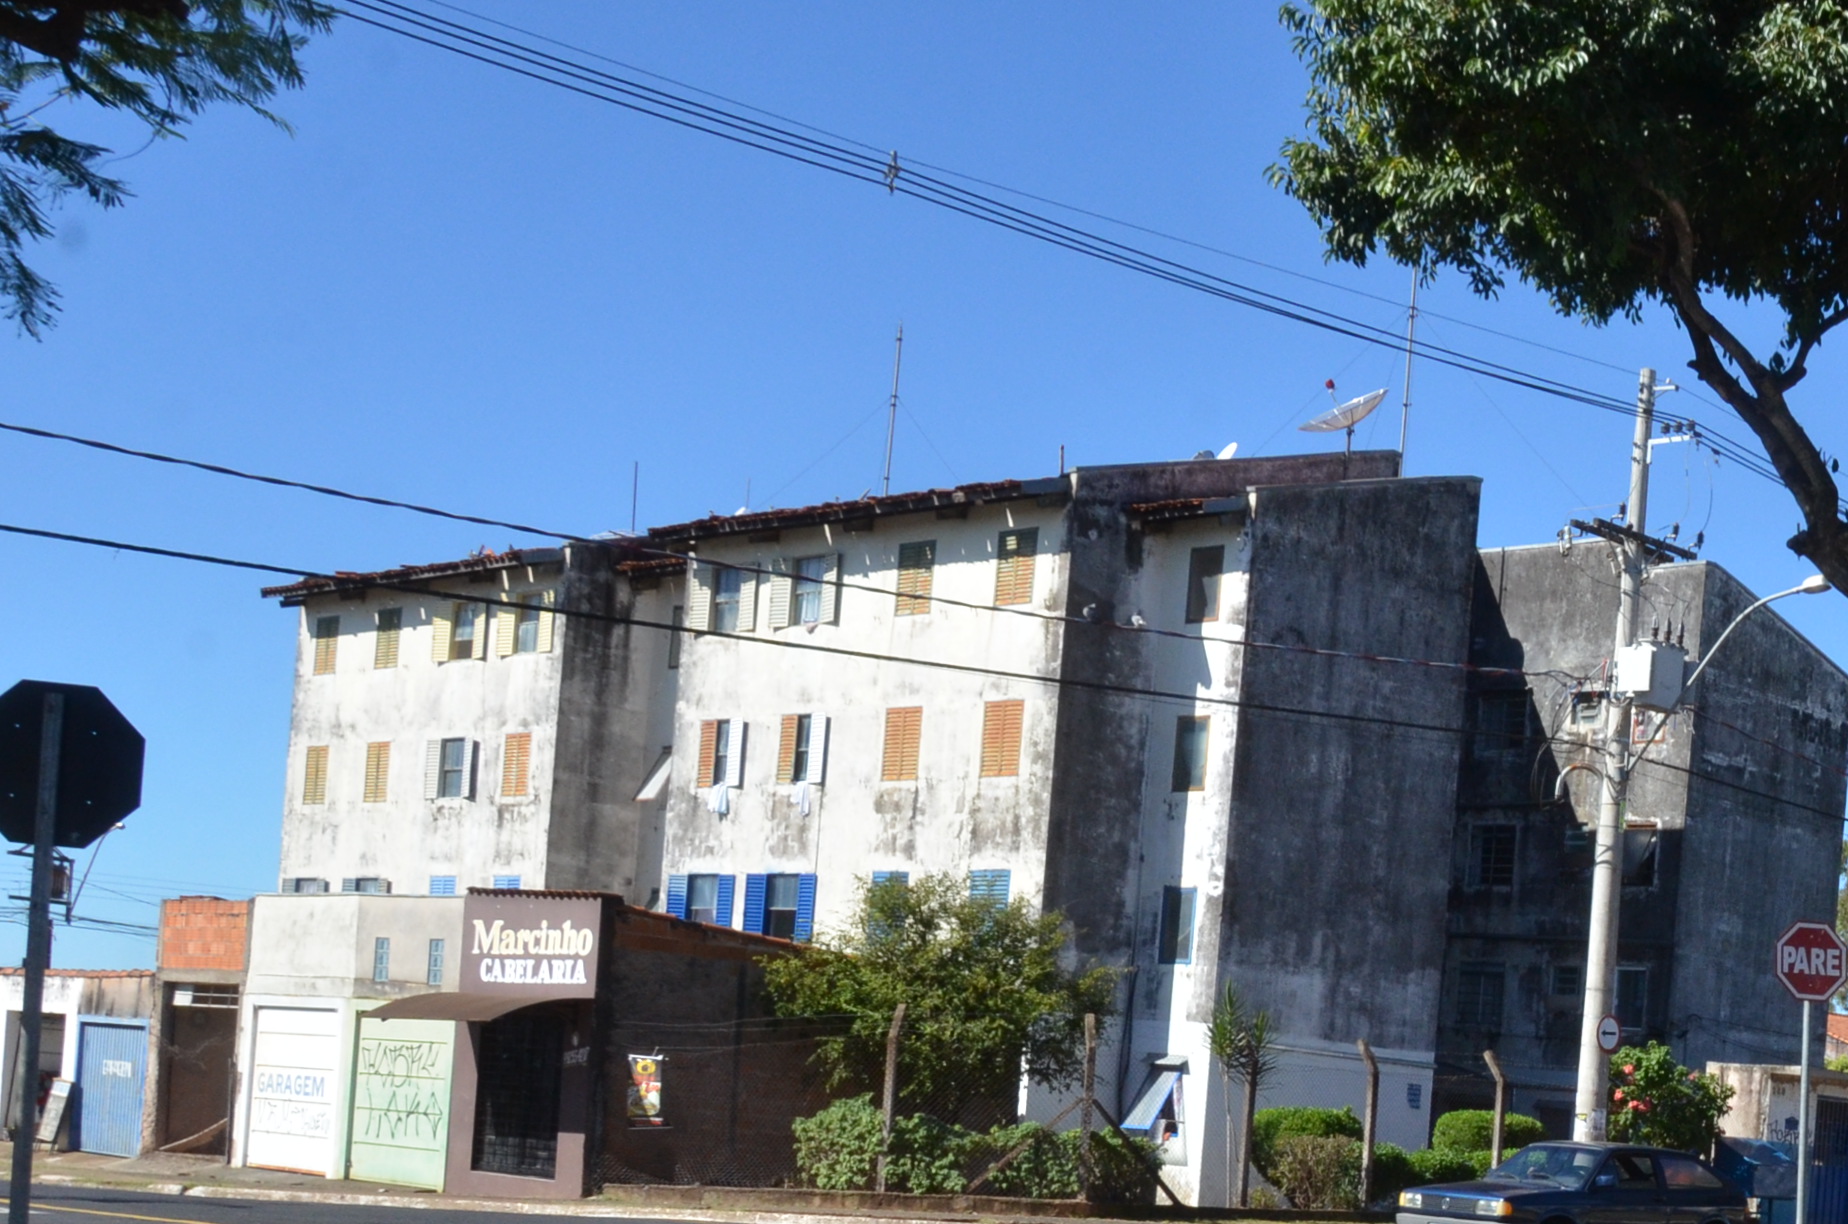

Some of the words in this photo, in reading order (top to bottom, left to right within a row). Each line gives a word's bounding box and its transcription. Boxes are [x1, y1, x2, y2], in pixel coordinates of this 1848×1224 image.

[471, 919, 594, 956] Marcinho
[479, 957, 588, 985] CABELARIA
[1782, 945, 1841, 977] PARE
[257, 1072, 325, 1098] GARAGEM
